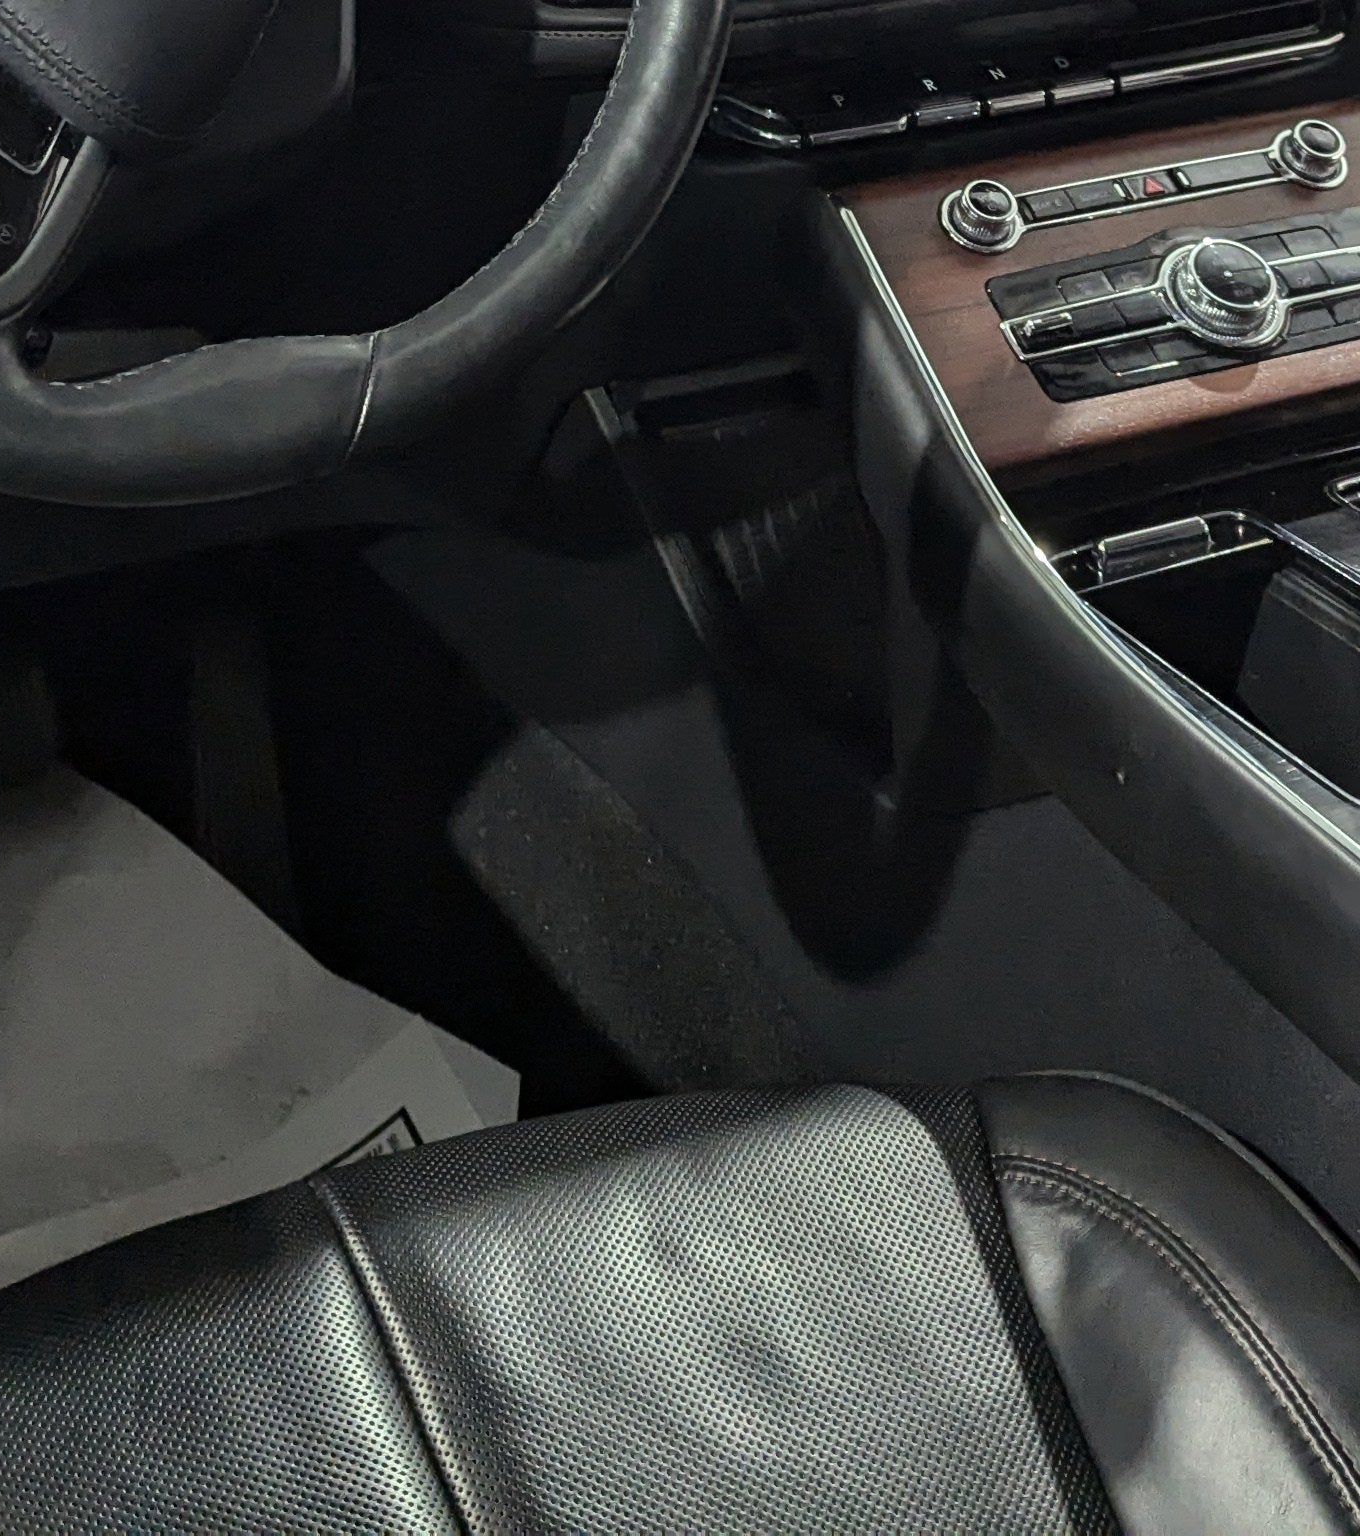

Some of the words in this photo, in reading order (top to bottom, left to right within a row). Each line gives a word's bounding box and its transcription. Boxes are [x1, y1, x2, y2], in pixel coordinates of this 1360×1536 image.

[832, 94, 845, 107] P
[922, 79, 938, 92] R
[989, 67, 1006, 80] N
[1054, 56, 1070, 68] D
